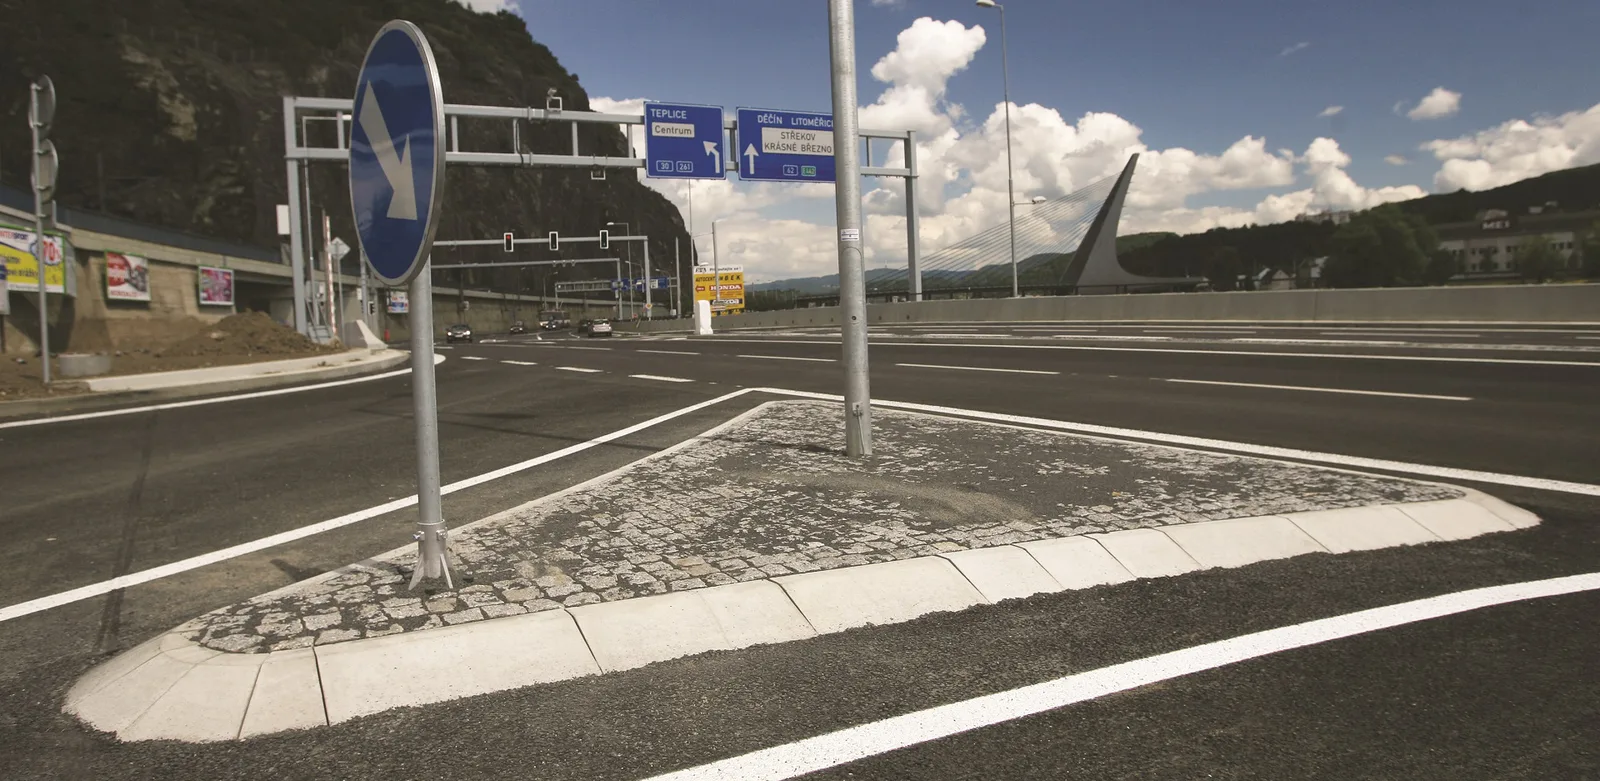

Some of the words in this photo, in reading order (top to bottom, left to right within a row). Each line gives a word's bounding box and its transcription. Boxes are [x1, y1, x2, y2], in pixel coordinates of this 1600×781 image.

[650, 109, 687, 119] TEPLICE
[757, 114, 783, 124] DĚČÍN
[655, 125, 692, 135] Centrum
[780, 130, 816, 141] STŘEKOV
[764, 142, 797, 152] KRÁSNÉ
[801, 143, 832, 153] BŘEZNO
[660, 162, 670, 170] 30
[0, 231, 28, 239] NTERSPORT
